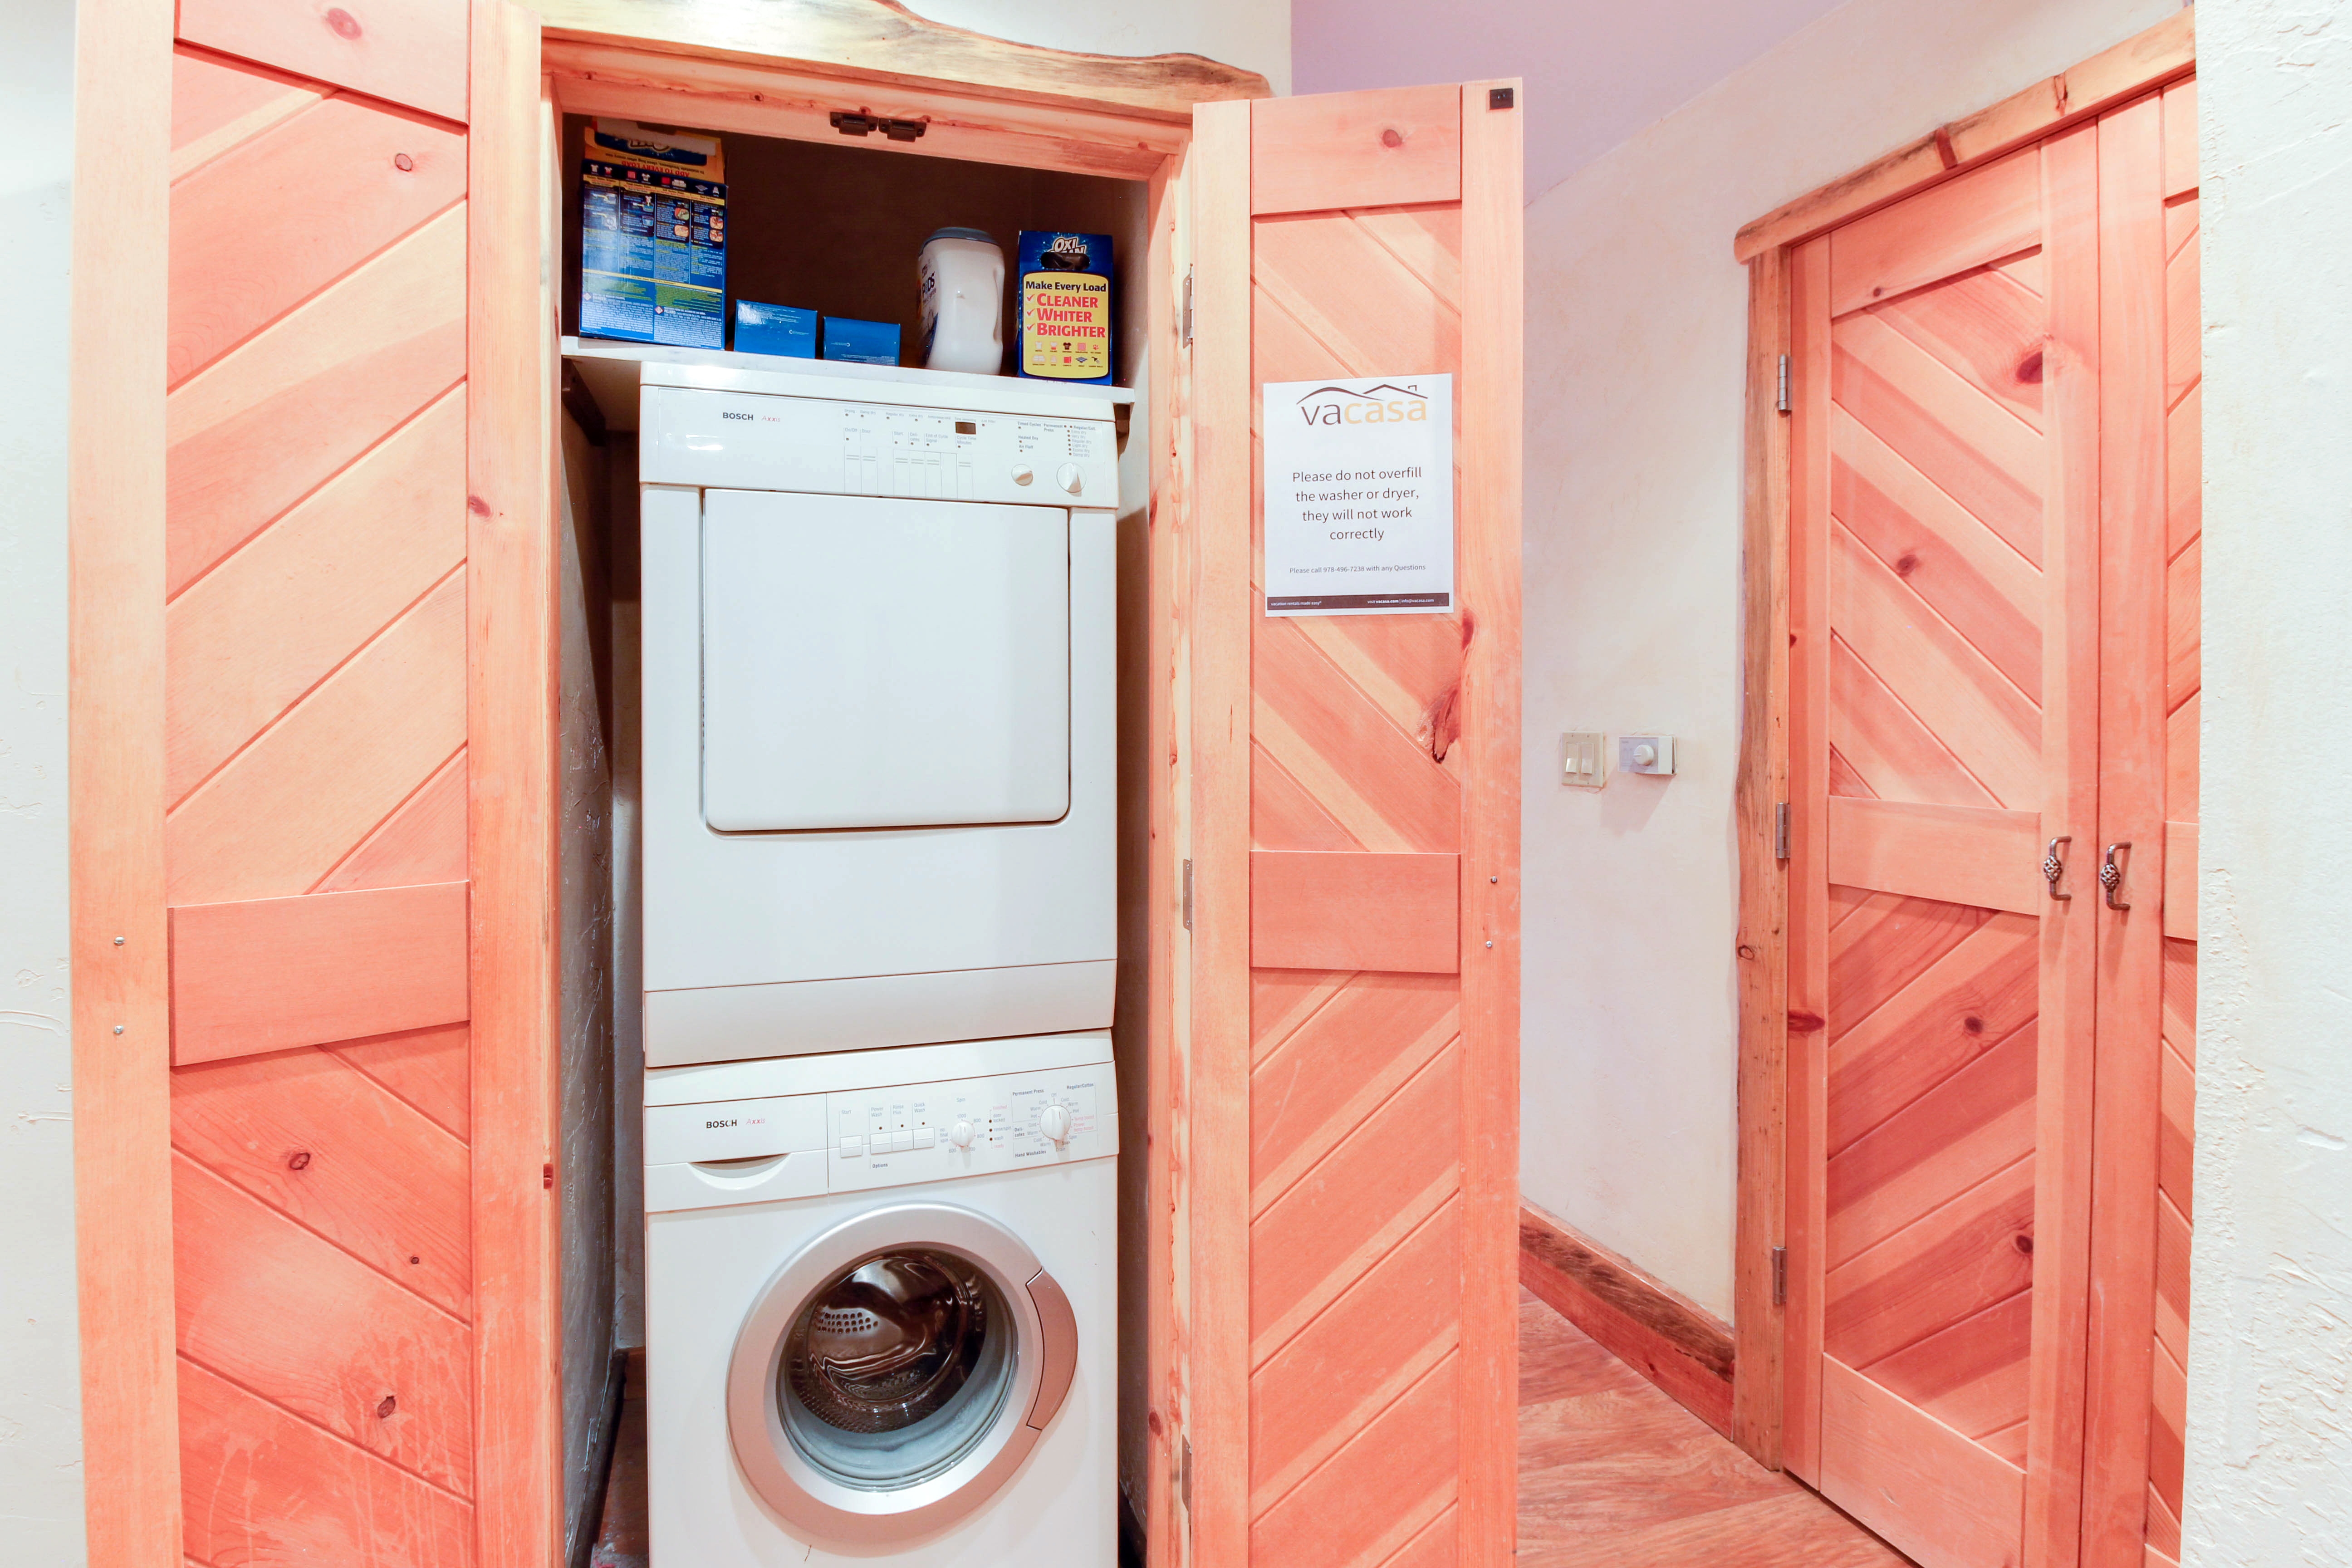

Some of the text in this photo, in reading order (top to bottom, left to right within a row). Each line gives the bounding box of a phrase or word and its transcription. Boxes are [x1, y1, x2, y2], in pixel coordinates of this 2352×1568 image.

[1053, 237, 1078, 253] OXI
[1026, 280, 1106, 293] Make Every Load
[1037, 293, 1098, 308] CLEANER
[1037, 308, 1093, 323] WHITER
[1037, 323, 1105, 338] BRIGHTER
[723, 412, 754, 421] BOSCH
[1301, 399, 1426, 425] vacasa
[1293, 467, 1421, 482] Please do not overfill
[1296, 488, 1419, 502] the washer or dryer,
[1303, 507, 1412, 523] they will not work
[1330, 528, 1384, 541] correctly
[706, 1119, 737, 1129] BOSCH
